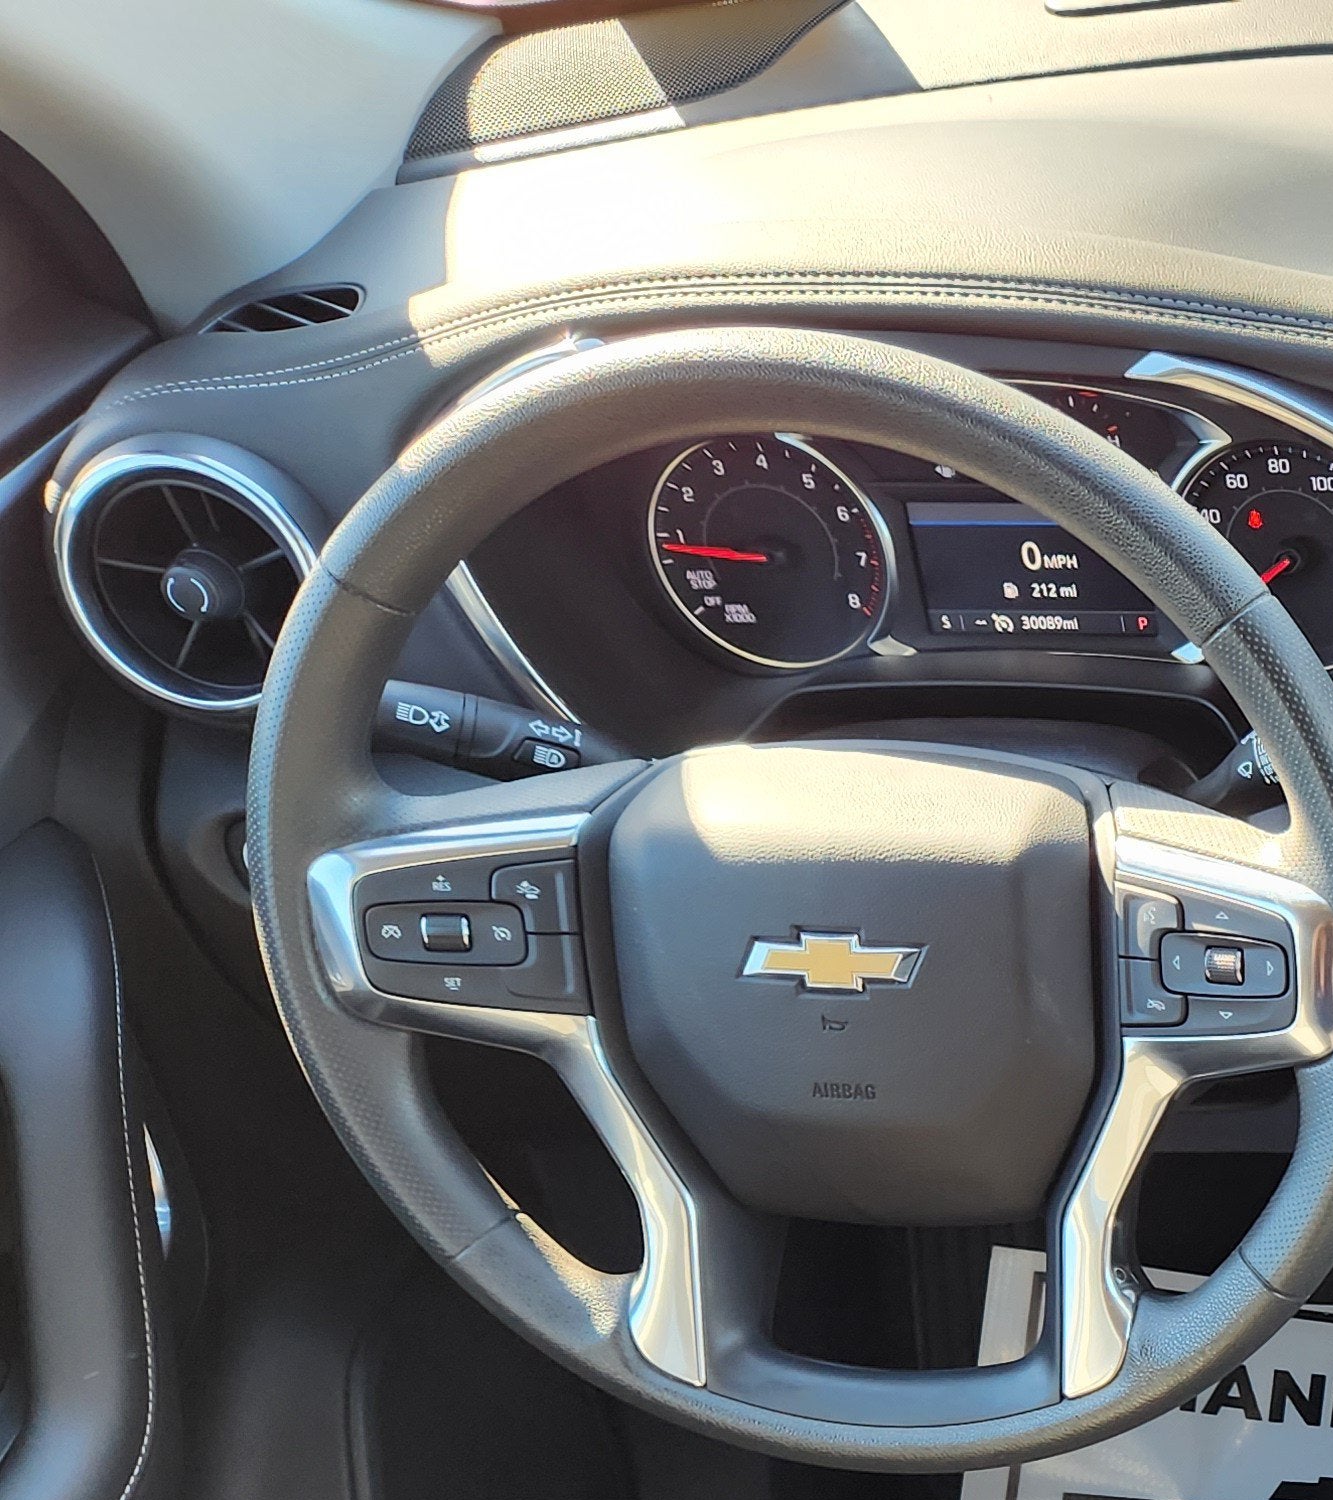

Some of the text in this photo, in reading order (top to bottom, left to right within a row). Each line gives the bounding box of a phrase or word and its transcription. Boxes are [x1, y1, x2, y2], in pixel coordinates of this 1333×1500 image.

[711, 459, 725, 476] 3
[755, 454, 769, 470] 4
[1267, 458, 1290, 474] 80
[802, 473, 816, 489] 5
[1225, 473, 1249, 489] 60
[681, 486, 695, 503] 2
[836, 506, 850, 522] 6
[855, 551, 867, 567] 7
[1021, 541, 1079, 571] 0 MPH
[686, 570, 714, 582] AUTO
[690, 580, 717, 591] STOP
[1031, 583, 1078, 598] 212 mi
[724, 603, 748, 614] RPM
[848, 593, 861, 609] 8
[1137, 616, 1149, 631] P
[431, 881, 451, 892] RES
[443, 977, 462, 988] SET
[812, 1082, 876, 1100] AIRBAG
